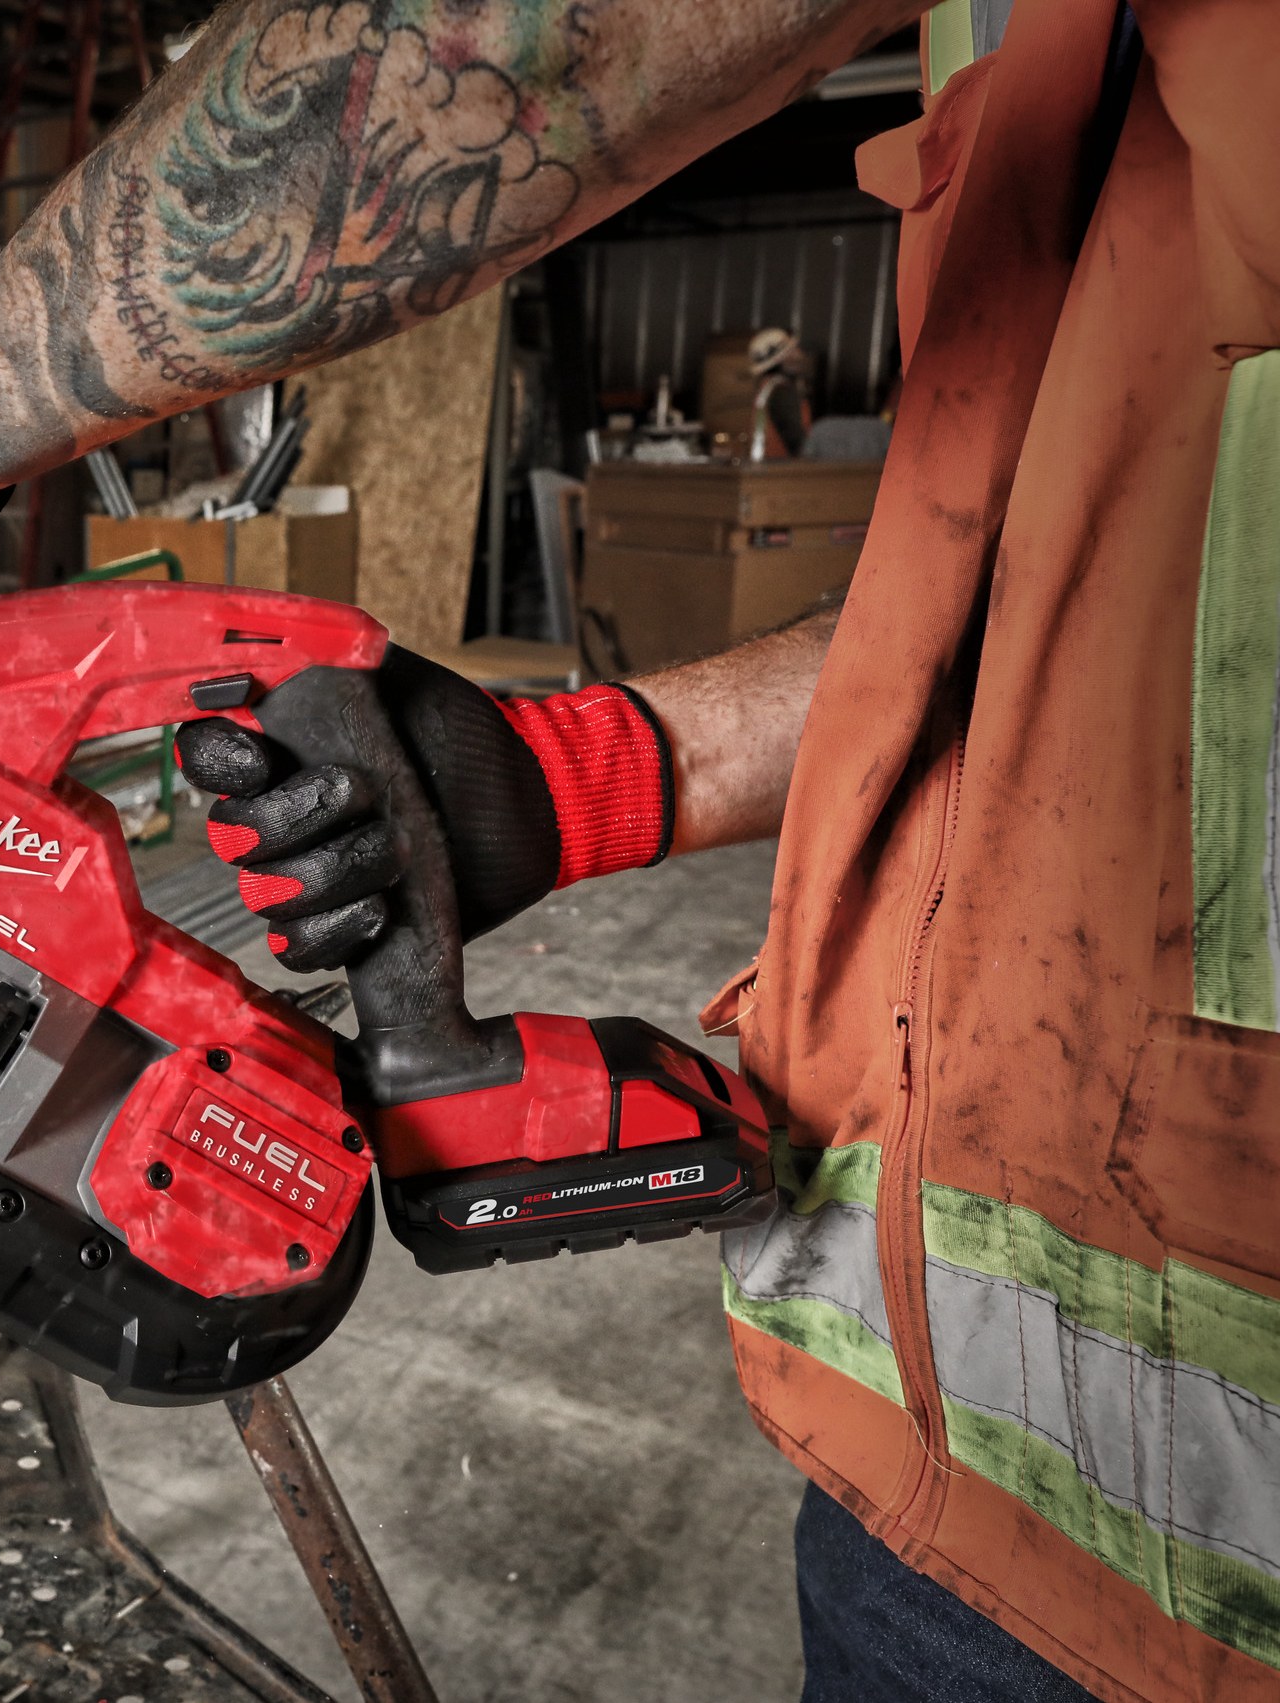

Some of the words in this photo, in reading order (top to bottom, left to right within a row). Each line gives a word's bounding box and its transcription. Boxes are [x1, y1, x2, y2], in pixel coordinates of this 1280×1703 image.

[189, 1129, 316, 1210] BRUSHLESS
[200, 1104, 326, 1193] FUEL
[650, 1167, 702, 1188] M18
[466, 1198, 518, 1225] 2.0
